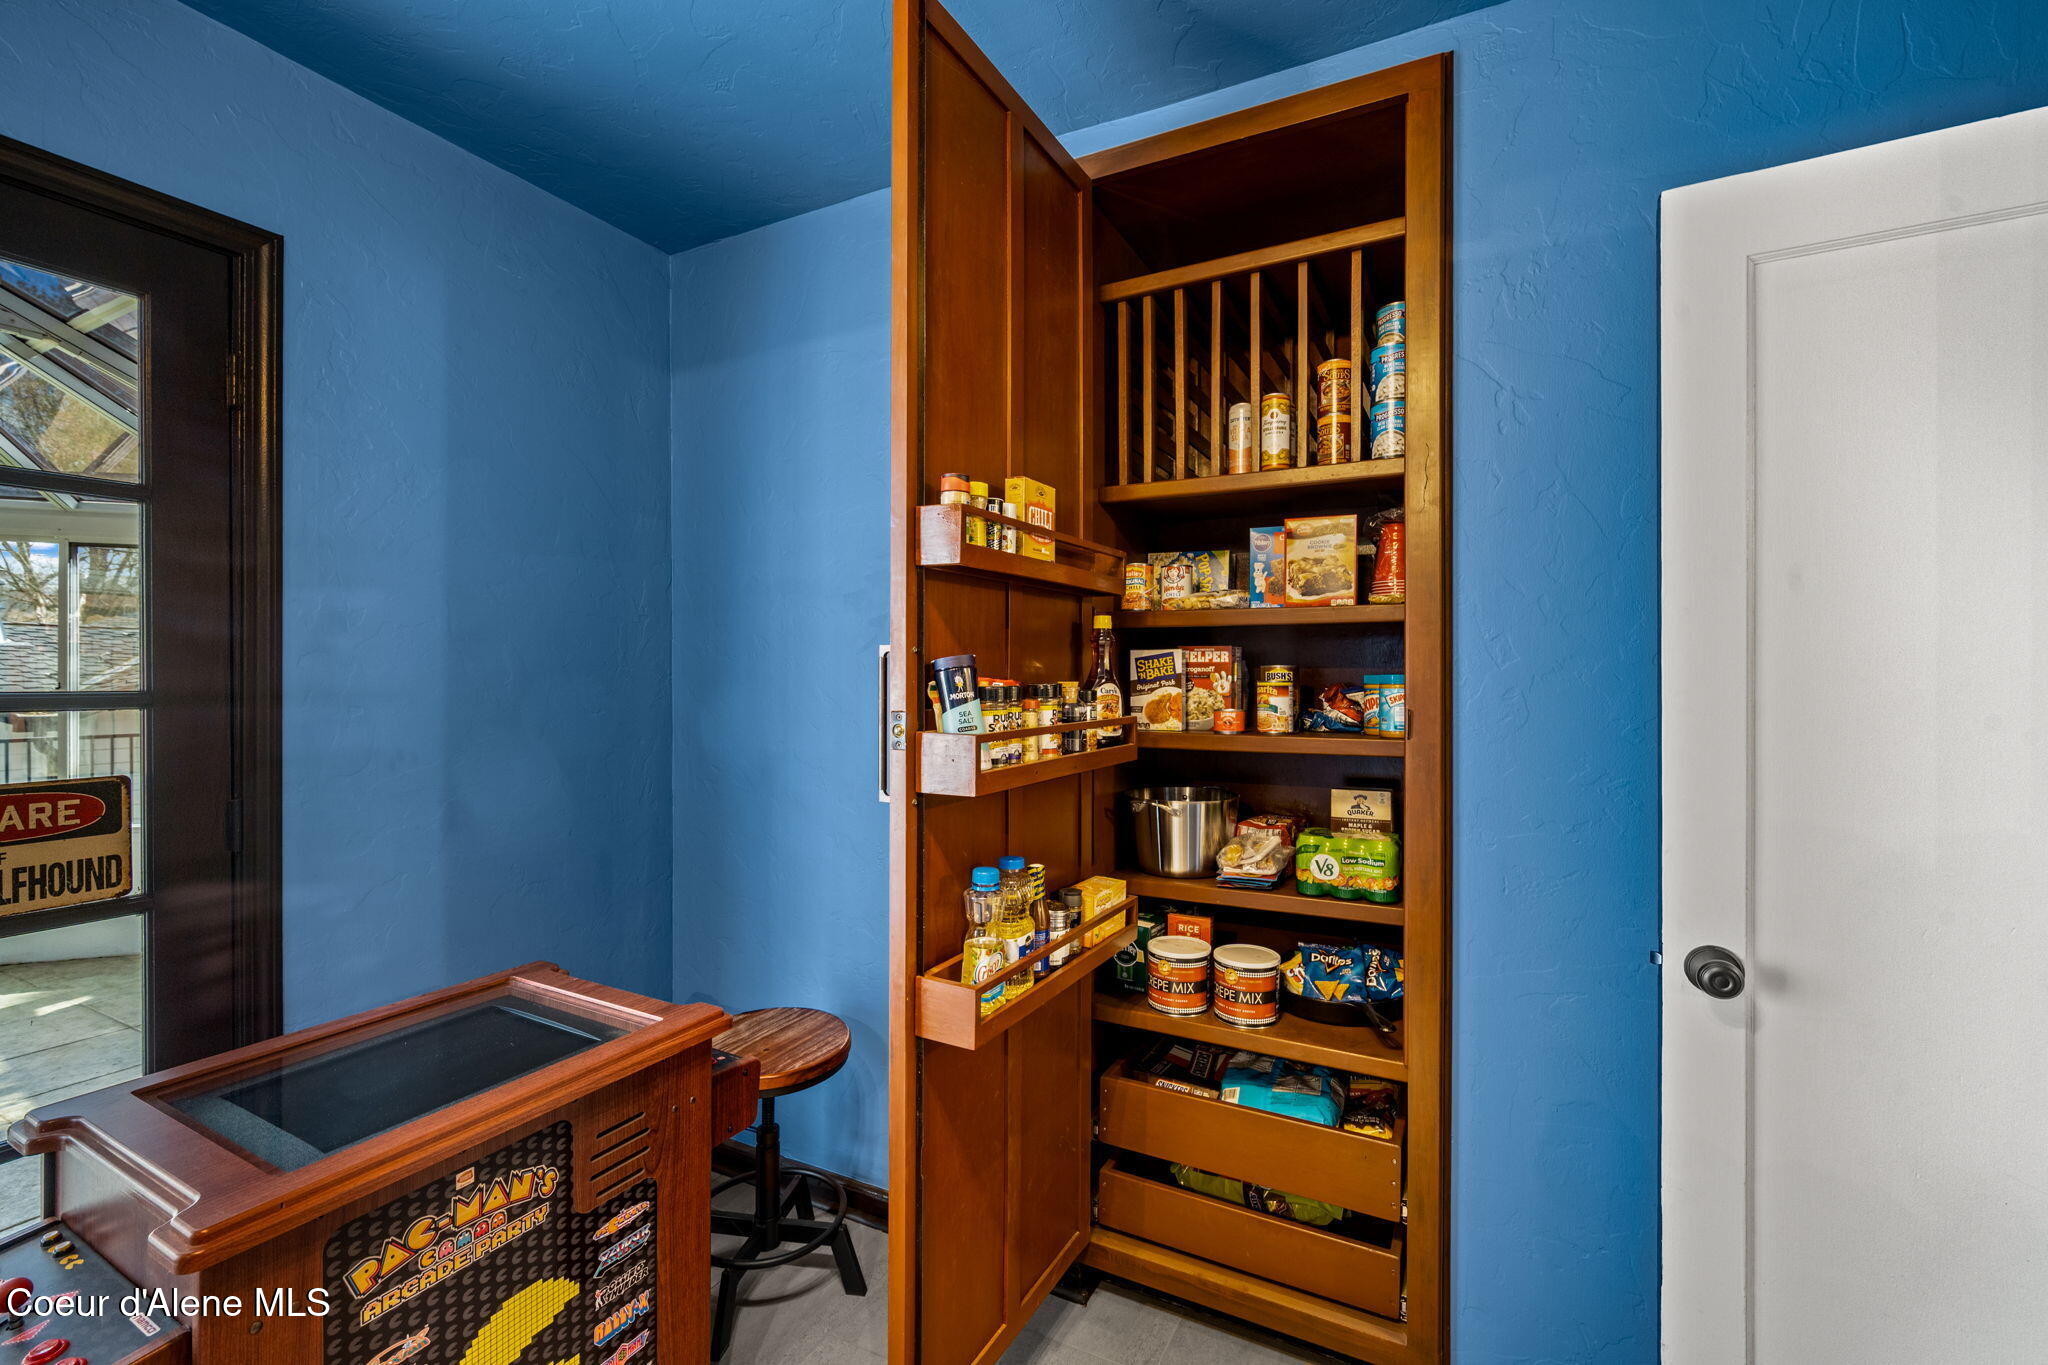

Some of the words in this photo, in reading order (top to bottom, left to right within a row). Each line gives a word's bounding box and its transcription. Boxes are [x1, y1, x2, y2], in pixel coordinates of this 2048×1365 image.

[1029, 505, 1053, 530] CHILI
[1136, 656, 1174, 673] SHAKE
[1146, 665, 1175, 681] BAKE
[1266, 672, 1292, 681] BUSH'S
[1136, 682, 1160, 691] Original
[949, 691, 975, 700] MORTON
[958, 710, 972, 718] SEA
[958, 717, 974, 725] SALT
[1346, 809, 1374, 817] QUAKER
[1314, 857, 1335, 877] V8
[1357, 857, 1385, 867] Sodium
[1177, 923, 1200, 934] RICE
[1311, 952, 1353, 966] Doritos
[1171, 981, 1195, 994] MIX
[1238, 991, 1263, 1005] MIX
[343, 1165, 559, 1299] PAC-MAN'S
[360, 1245, 474, 1327] ARCADE
[474, 1201, 550, 1262] PARTY
[593, 1290, 650, 1347] RALLY-X
